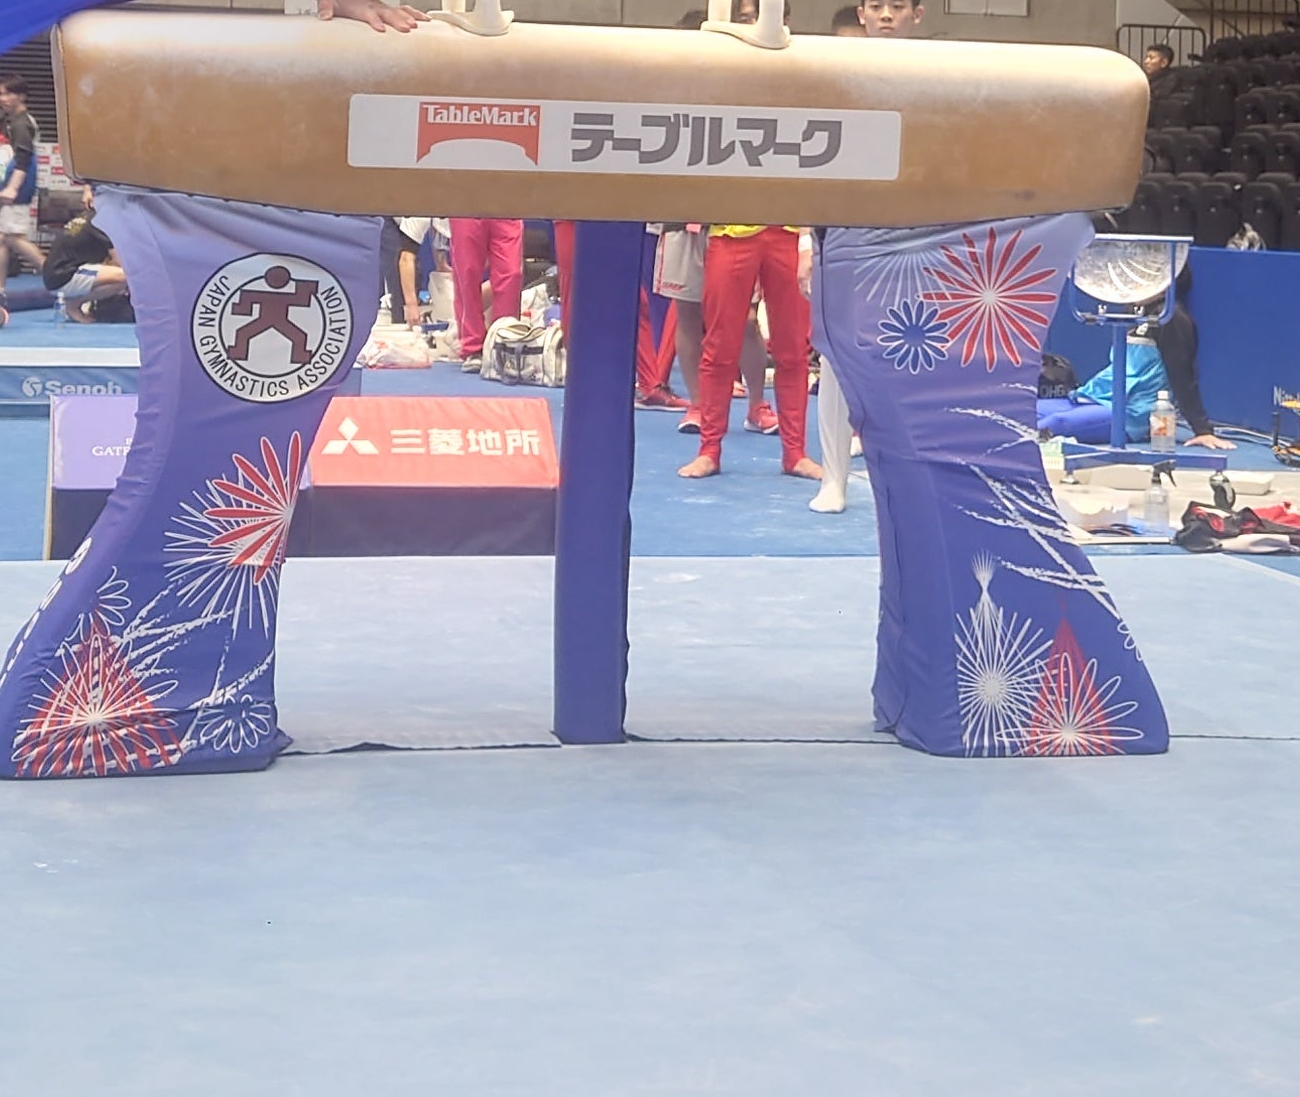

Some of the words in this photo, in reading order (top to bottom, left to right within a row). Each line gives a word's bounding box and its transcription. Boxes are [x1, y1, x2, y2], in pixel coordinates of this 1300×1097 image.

[422, 104, 538, 127] TableMark
[570, 112, 843, 169] テーブルマーク
[198, 275, 230, 328] JAPAN
[297, 286, 347, 391] ASSOCIATION
[45, 380, 123, 395] Senoh
[199, 335, 290, 397] GYMNASTICS
[390, 428, 541, 456] 三菱地所
